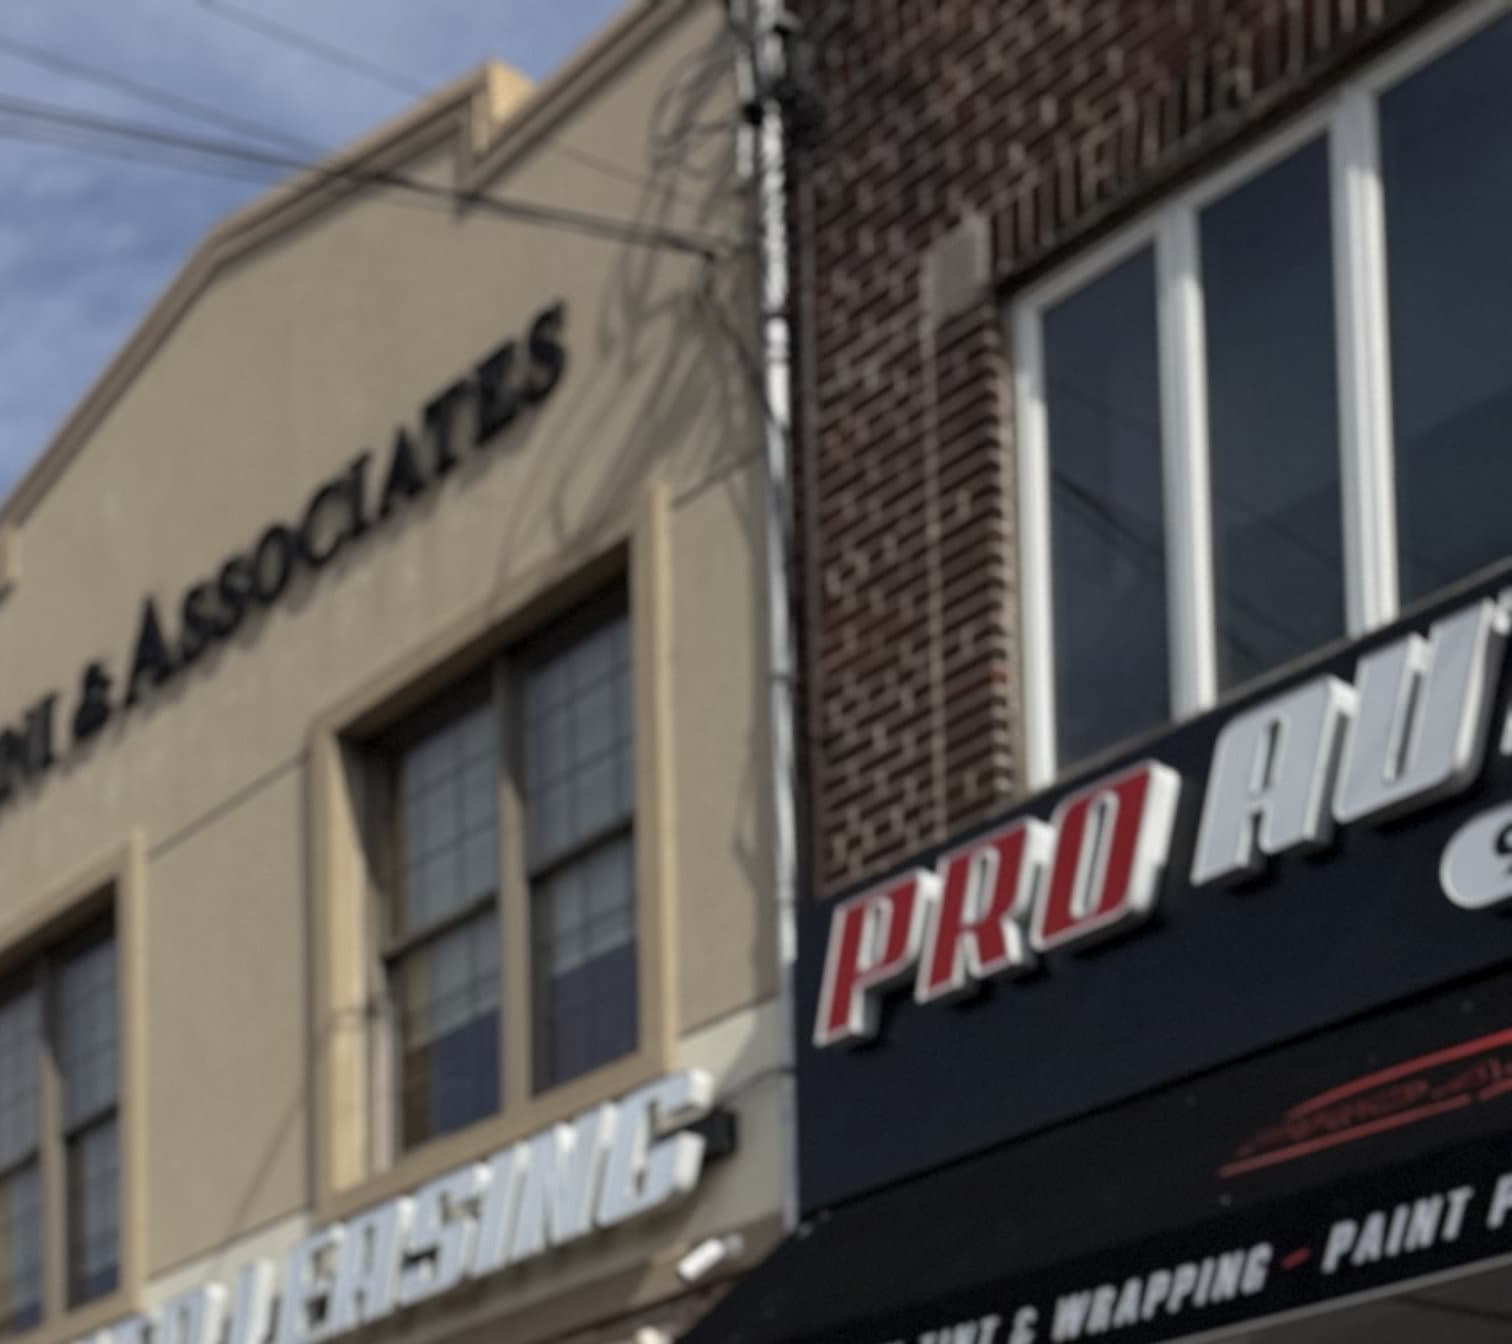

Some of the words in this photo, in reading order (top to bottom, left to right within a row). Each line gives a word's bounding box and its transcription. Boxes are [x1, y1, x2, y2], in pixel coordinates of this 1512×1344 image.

[74, 661, 114, 742] &
[124, 300, 568, 712] ASSOCIATES
[813, 758, 1181, 1048] PRO
[1050, 1242, 1274, 1344] WRAPPING
[1321, 1186, 1476, 1274] PAINT
